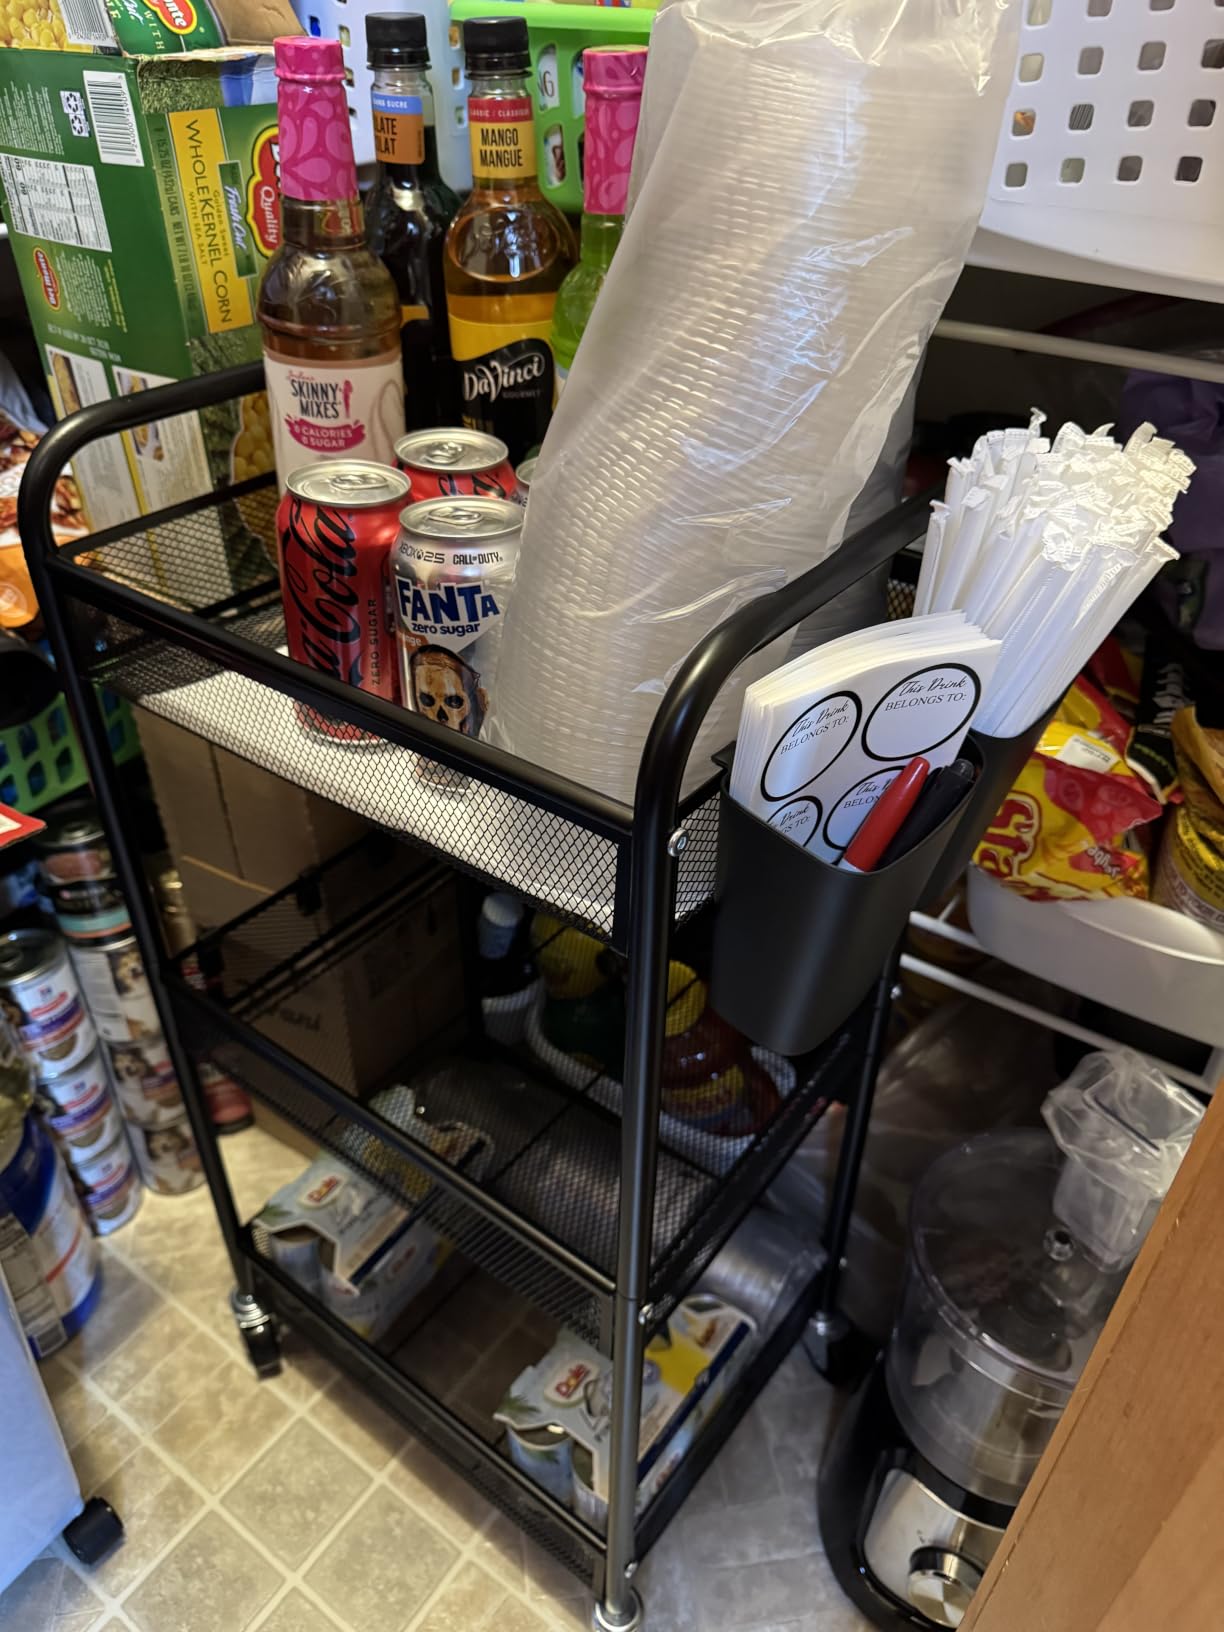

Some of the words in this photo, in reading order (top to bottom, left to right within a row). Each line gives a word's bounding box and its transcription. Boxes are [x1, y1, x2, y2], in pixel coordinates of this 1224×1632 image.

[144, 10, 165, 49] WITH
[481, 127, 519, 147] MANGO
[480, 148, 524, 168] MANGUE
[189, 191, 199, 218] WITH
[224, 184, 243, 222] Fresh
[261, 185, 279, 244] Quality
[186, 119, 211, 196] WHOLE
[200, 198, 223, 267] KERNEL
[213, 270, 233, 324] CORN
[193, 222, 203, 240] SEA
[198, 243, 208, 265] SALT
[220, 229, 230, 257] Sweet
[463, 353, 545, 403] DaVinci
[290, 379, 340, 402] SKINNY
[300, 400, 340, 419] MIXES
[302, 426, 353, 438] CALORIES
[310, 438, 346, 448] SUGAR
[423, 551, 445, 564] 25
[453, 554, 474, 565] CALL
[478, 551, 500, 564] DUTY
[397, 578, 500, 625] FANTA
[367, 599, 379, 646] SUGAR
[412, 622, 438, 634] zero
[439, 623, 481, 637] sugar
[370, 650, 381, 686] ZERO
[899, 681, 926, 697] This
[927, 675, 968, 692] Drink
[885, 695, 943, 712] BELONGS
[946, 692, 967, 702] TO:
[791, 718, 814, 738] This
[816, 700, 849, 724] Drink
[780, 723, 831, 756] BELONGS
[832, 715, 849, 729] TO:
[855, 781, 878, 796] This
[843, 795, 880, 809] BELON
[780, 803, 811, 826] Drink
[795, 815, 811, 826] TO:
[307, 1175, 338, 1204] Dole
[555, 1363, 591, 1399] Dole
